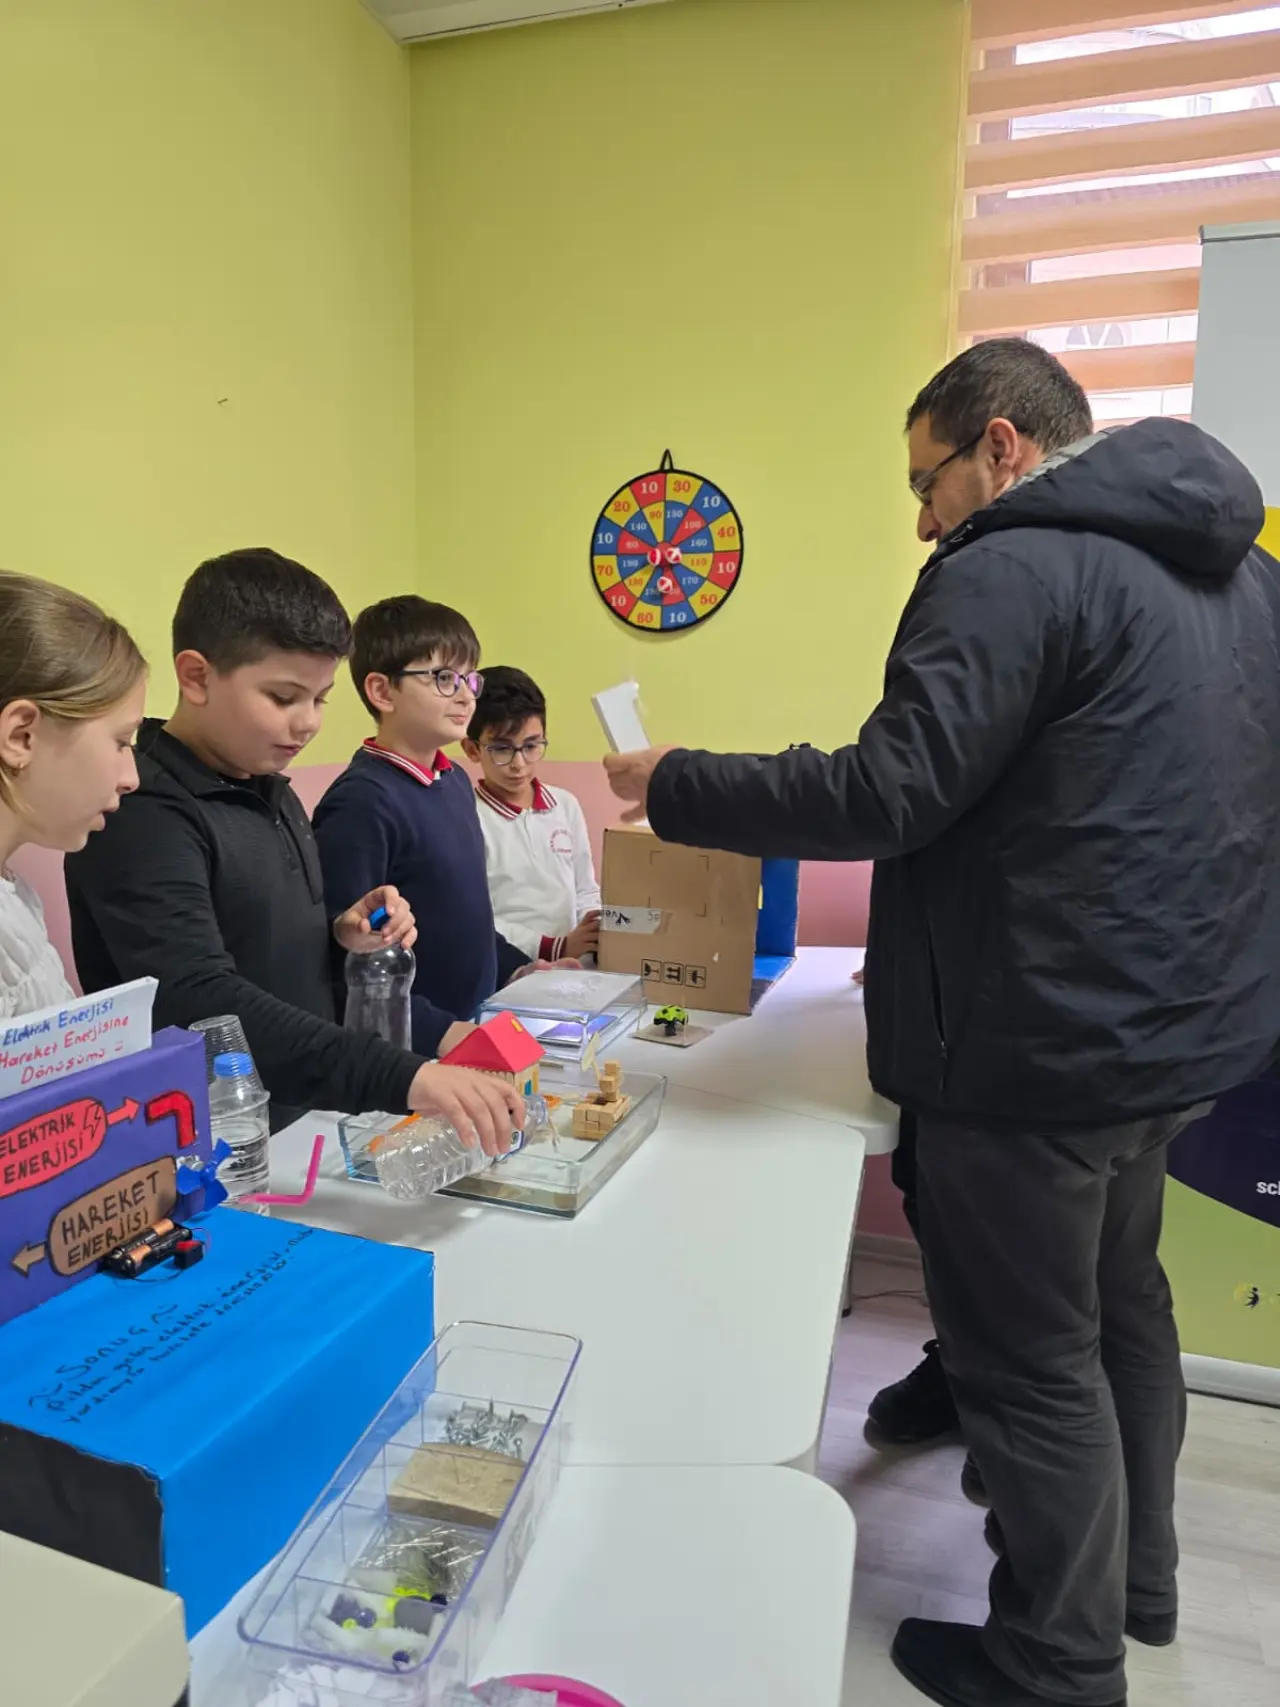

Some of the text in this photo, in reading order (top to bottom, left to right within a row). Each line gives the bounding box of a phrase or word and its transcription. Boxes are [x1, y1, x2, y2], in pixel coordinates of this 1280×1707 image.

[642, 482, 658, 494] 10
[673, 480, 691, 492] 30
[613, 501, 630, 512] 20
[702, 496, 720, 508] 10
[717, 527, 735, 537] 40
[597, 533, 613, 544] 10
[691, 539, 707, 547] 160
[597, 565, 612, 576] 70
[718, 563, 735, 573] 10
[682, 577, 698, 585] 170
[611, 596, 626, 606] 10
[700, 595, 717, 604] 50
[637, 613, 653, 623] 60
[669, 613, 686, 623] 10
[58, 998, 114, 1029] Enerjisi
[64, 1015, 129, 1049] Enerjisine
[61, 1170, 160, 1246] HAREKET
